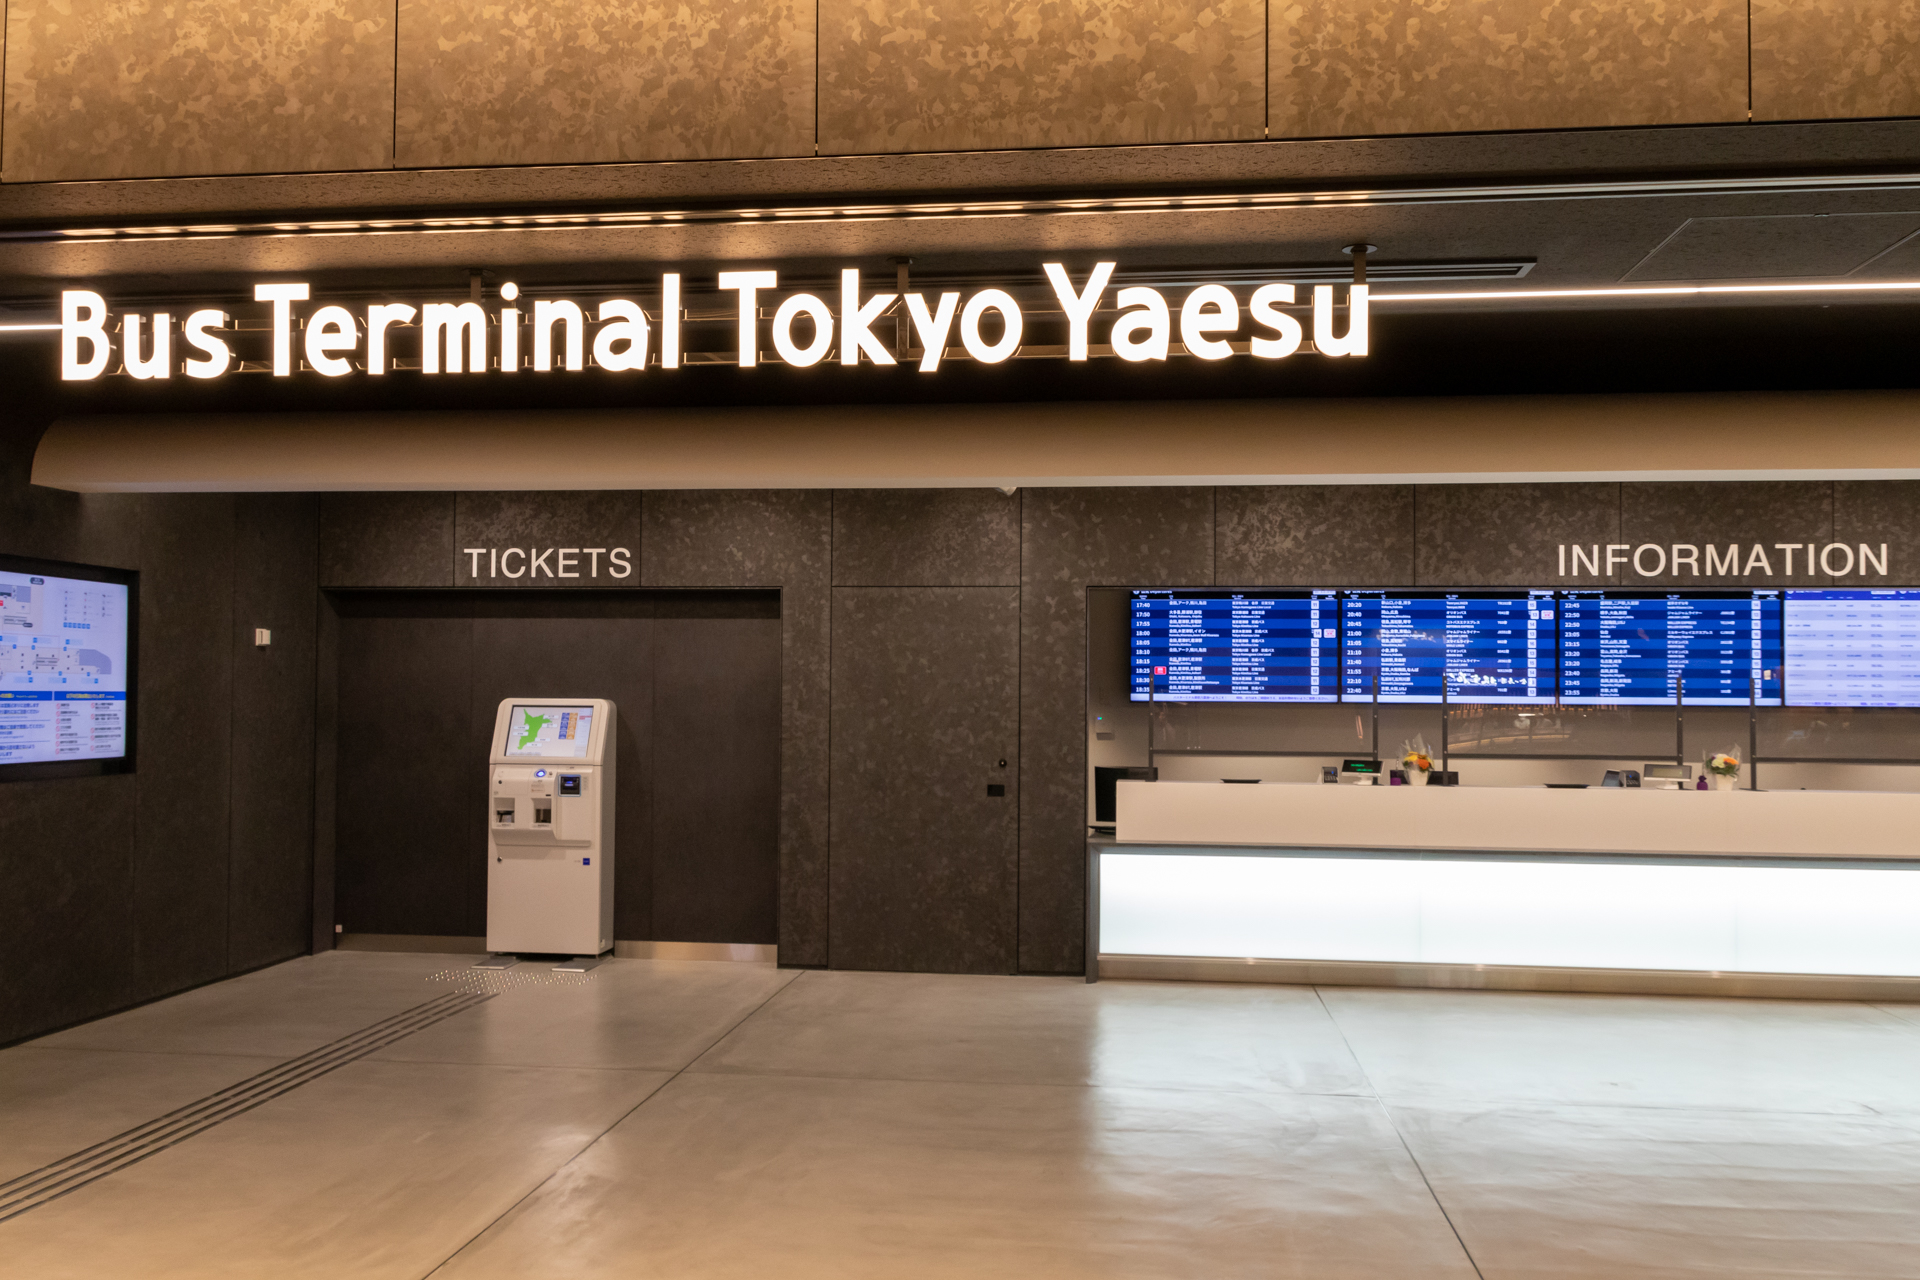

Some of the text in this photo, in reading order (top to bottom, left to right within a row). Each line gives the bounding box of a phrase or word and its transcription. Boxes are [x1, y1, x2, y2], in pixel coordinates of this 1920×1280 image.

[61, 261, 1370, 381] Bus Terminal Tokyo Yaesu
[463, 546, 633, 579] TICKETS
[1557, 541, 1889, 578] INFORMATION
